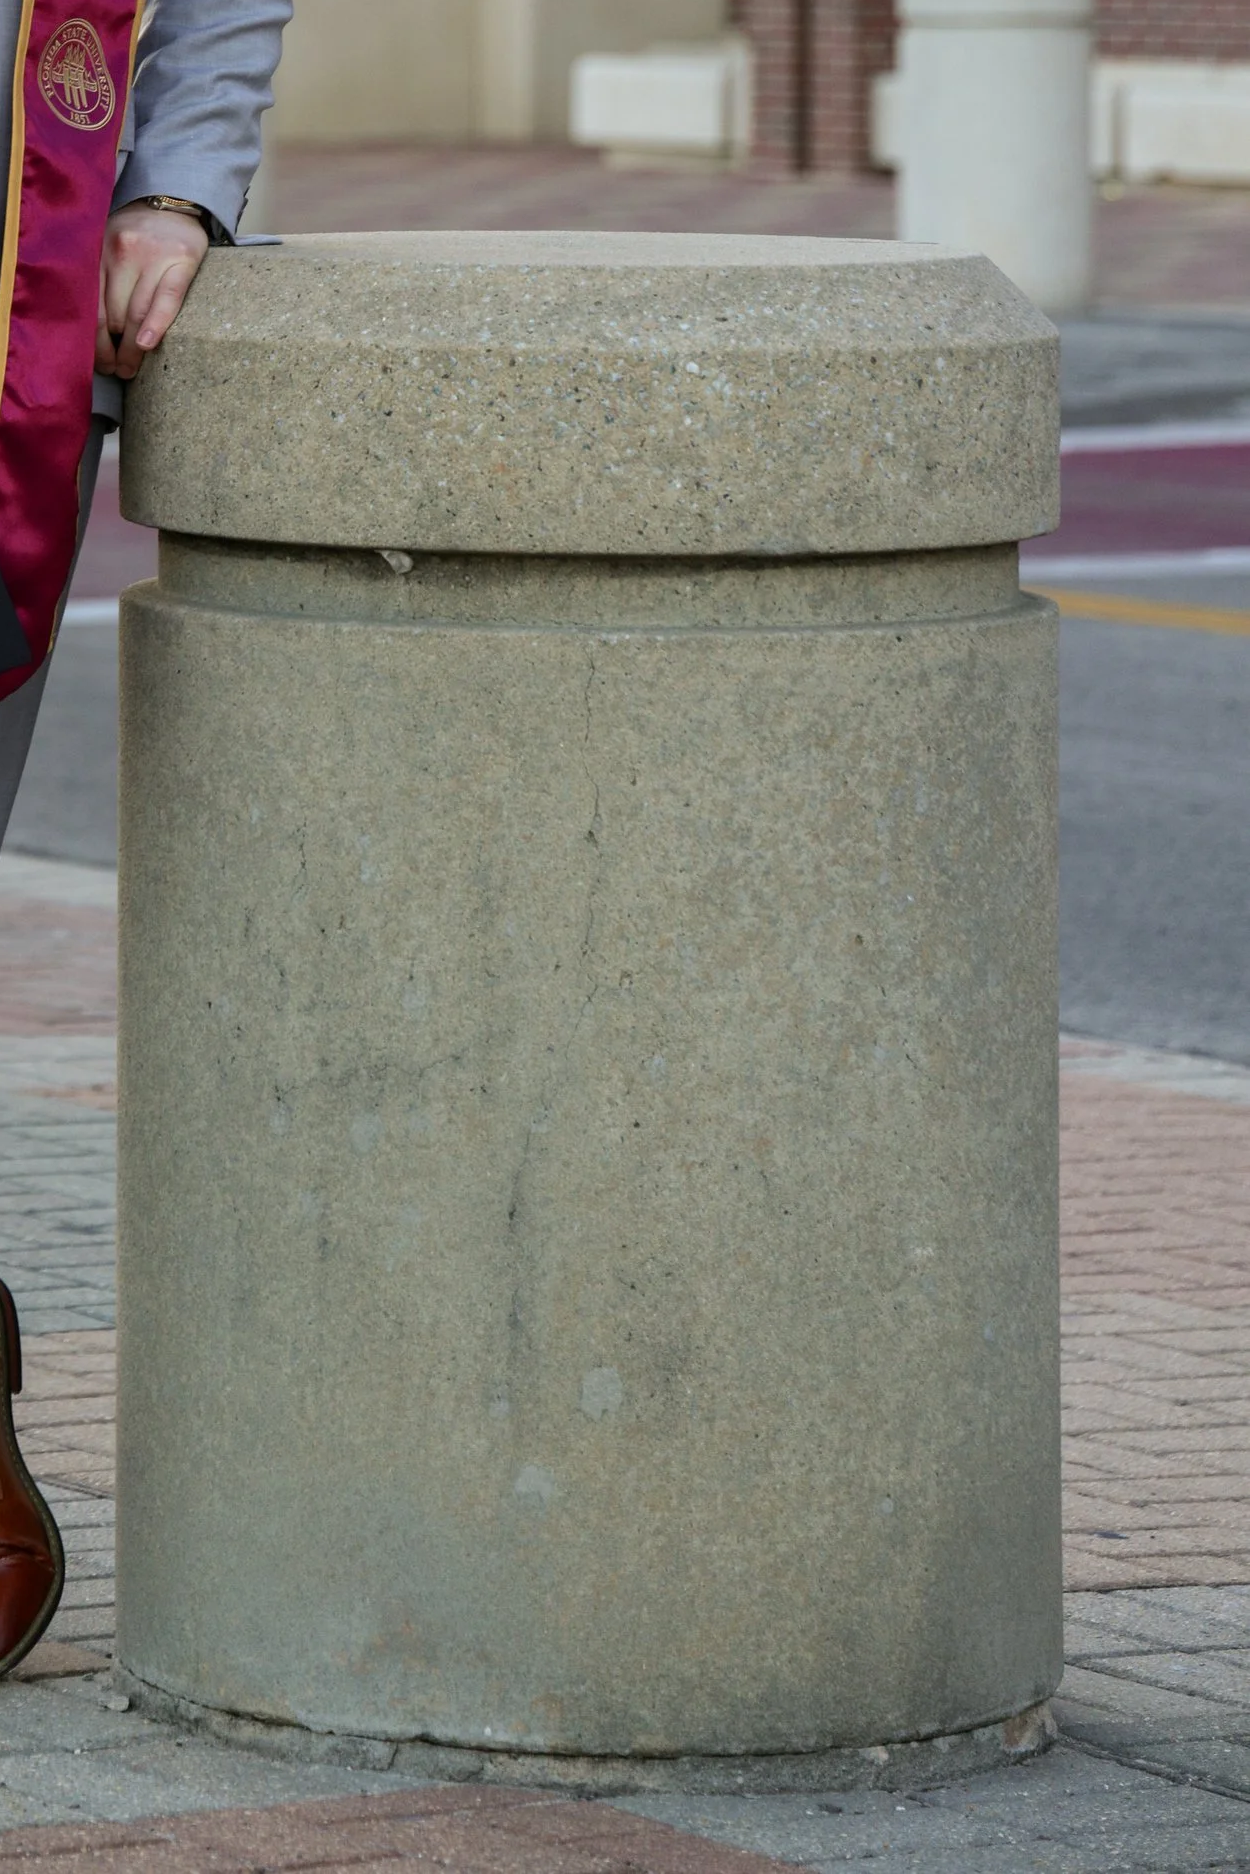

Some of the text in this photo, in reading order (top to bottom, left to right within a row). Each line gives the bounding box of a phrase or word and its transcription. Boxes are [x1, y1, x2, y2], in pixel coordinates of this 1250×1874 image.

[42, 27, 111, 111] FLORIDA STATE UNIVERSITY
[70, 112, 91, 124] 1851
